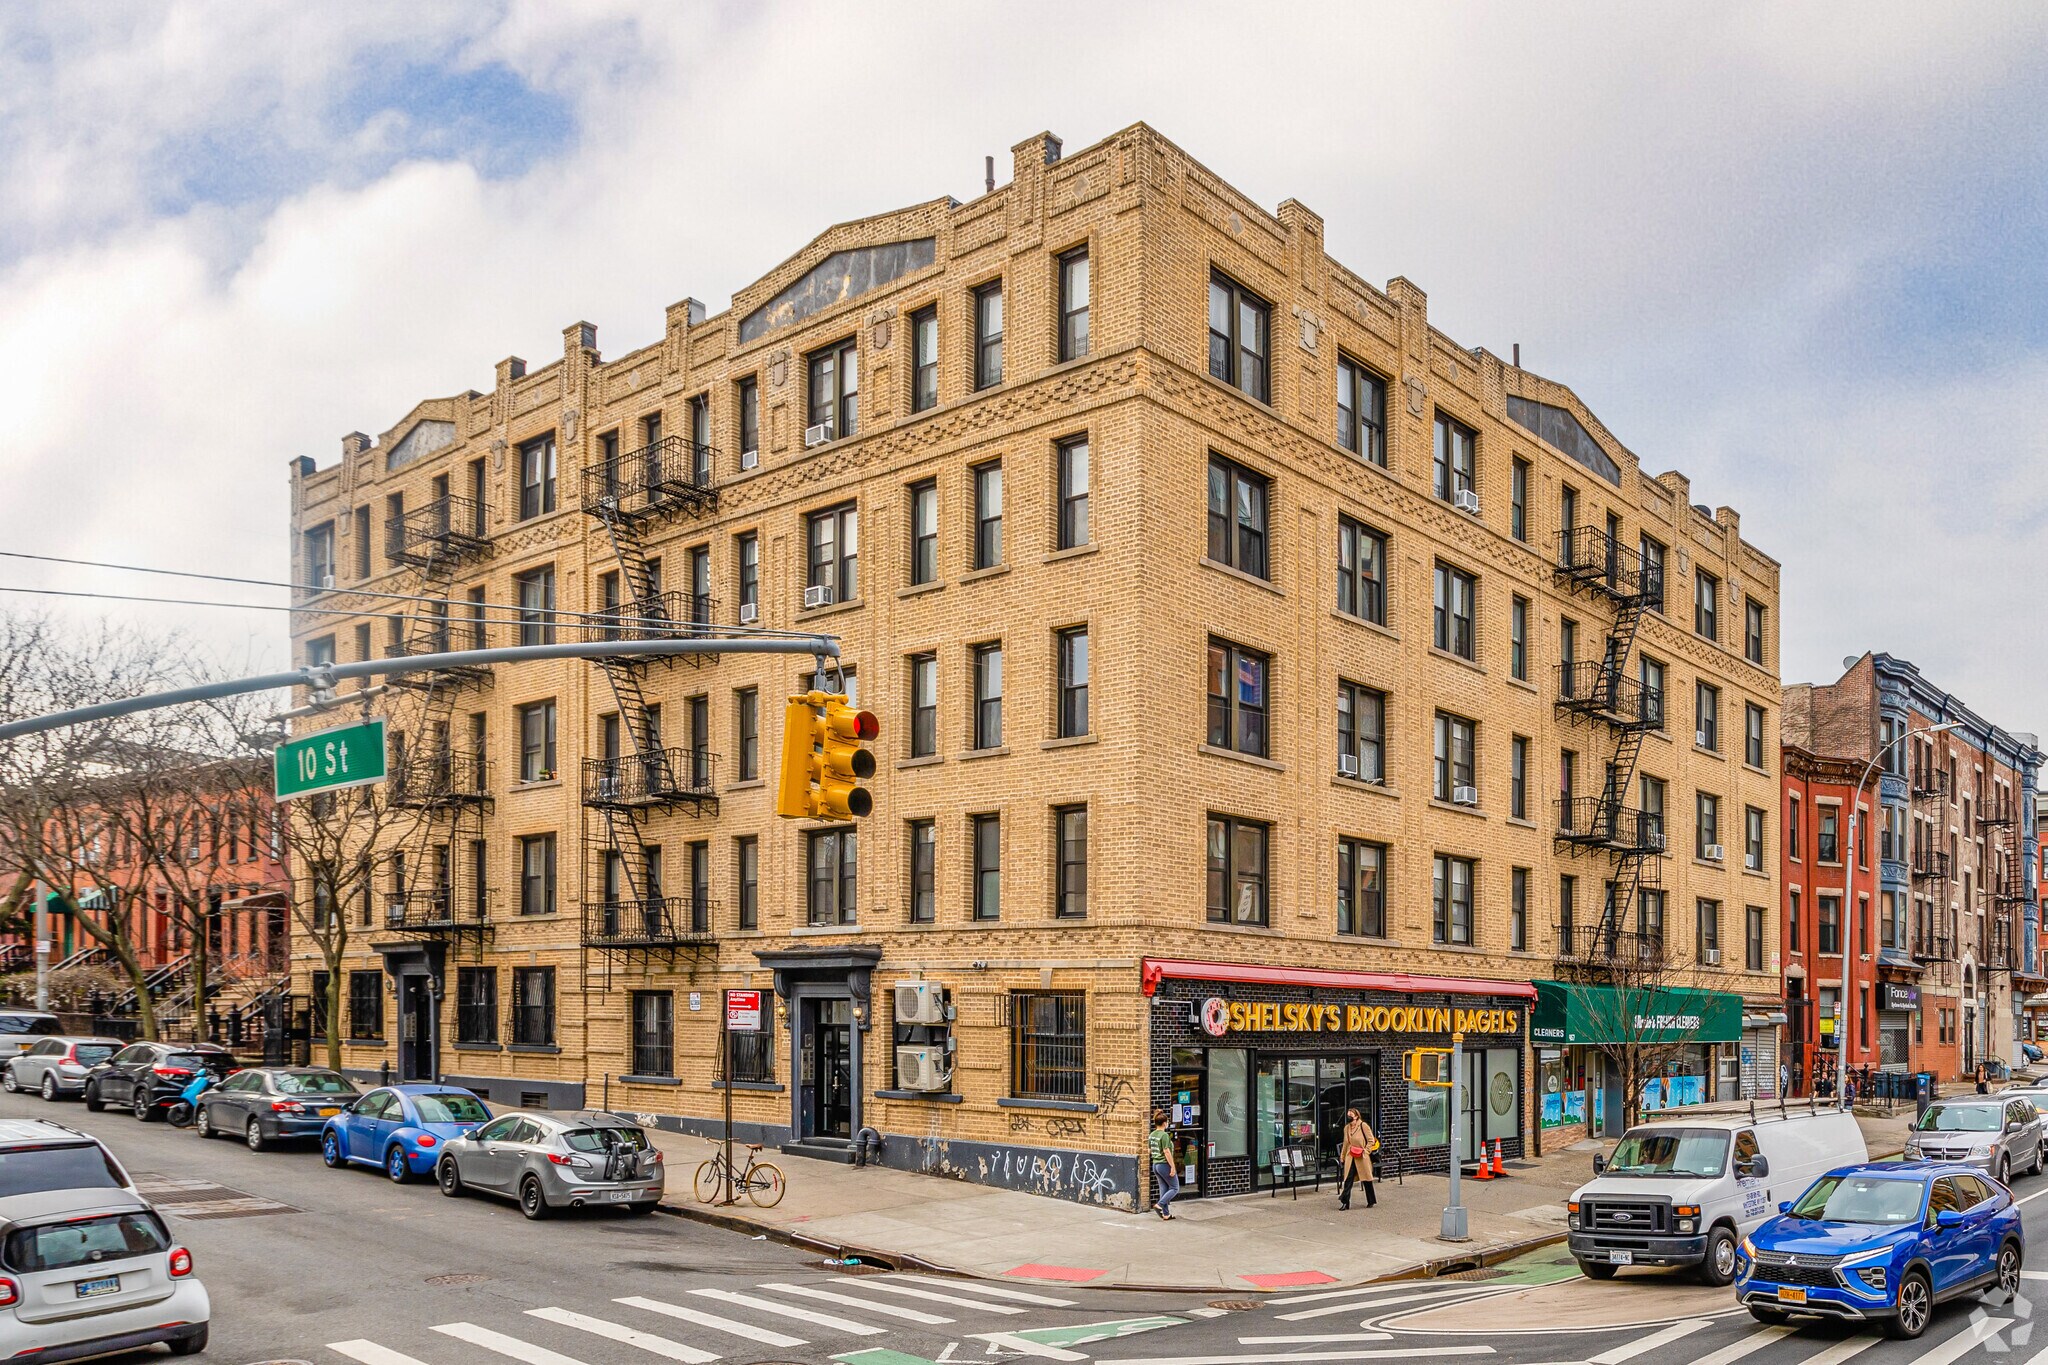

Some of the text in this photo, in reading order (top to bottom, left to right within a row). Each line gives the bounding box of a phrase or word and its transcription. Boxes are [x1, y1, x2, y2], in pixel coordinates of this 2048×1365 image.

[298, 739, 349, 782] 10 St
[1229, 1001, 1518, 1034] SHELSKY'S BROOKLYN BAGELS
[1533, 1027, 1565, 1038] CLEANERS
